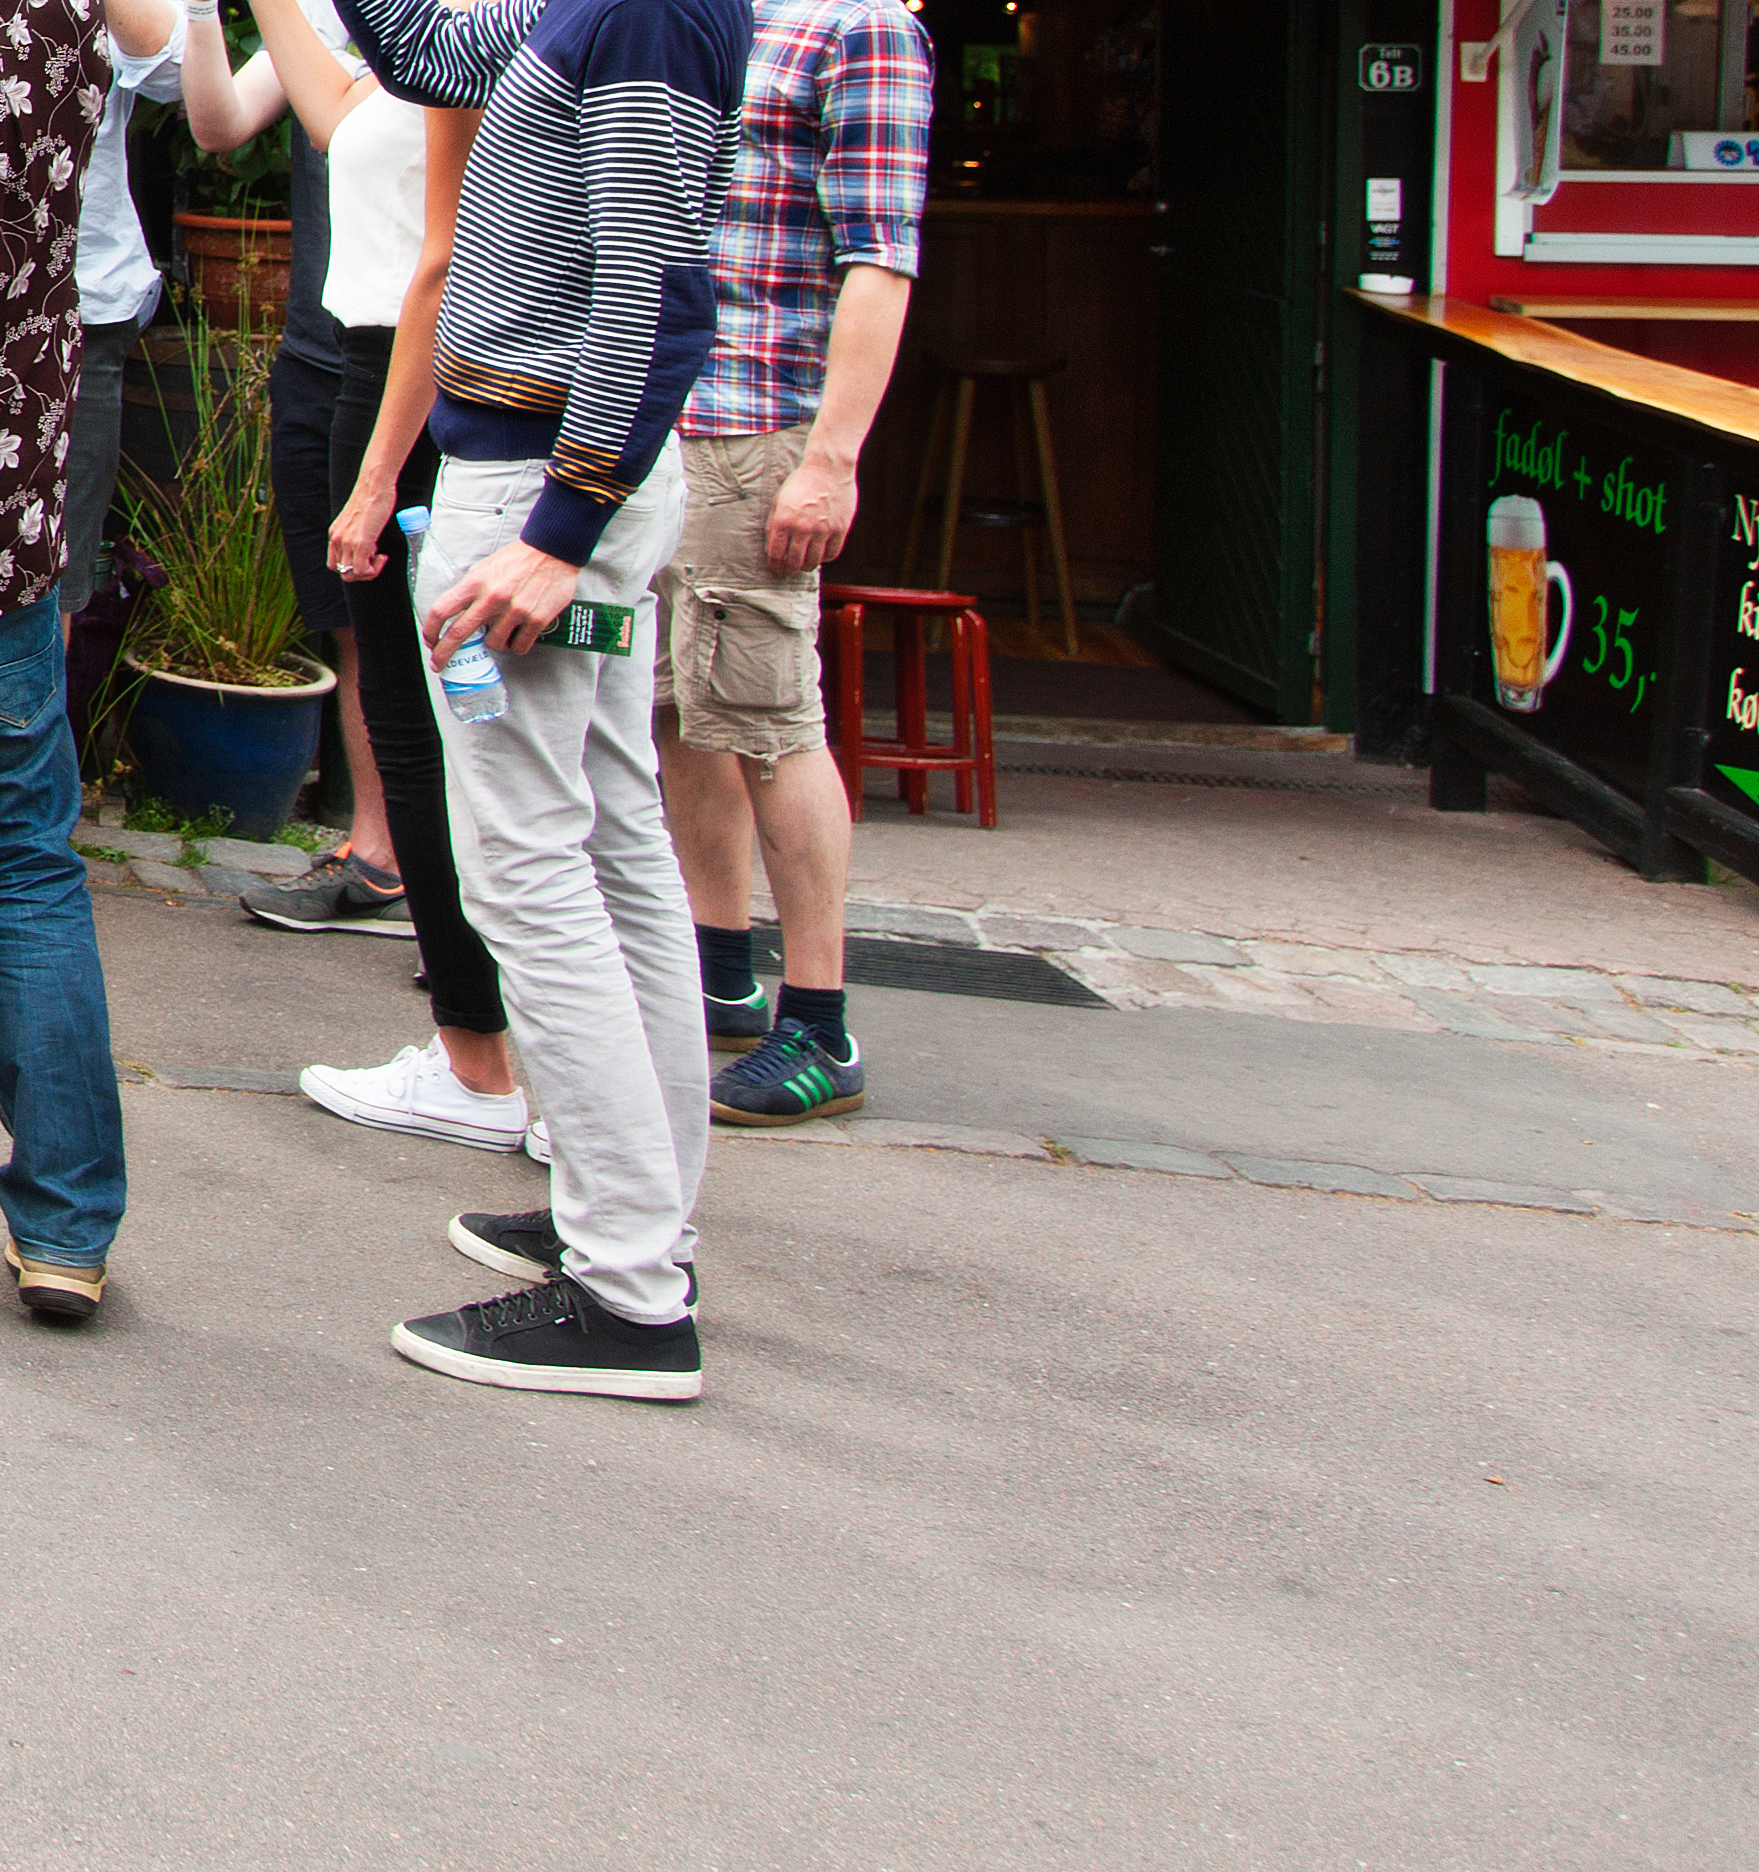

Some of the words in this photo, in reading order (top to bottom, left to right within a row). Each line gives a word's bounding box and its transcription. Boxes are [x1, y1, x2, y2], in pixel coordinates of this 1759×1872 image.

[1612, 5, 1655, 20] 25.00
[1609, 43, 1652, 57] 45.00
[1369, 59, 1415, 89] 6B
[1488, 408, 1568, 489] fadøl
[1573, 455, 1592, 501] +
[1601, 457, 1667, 534] shot
